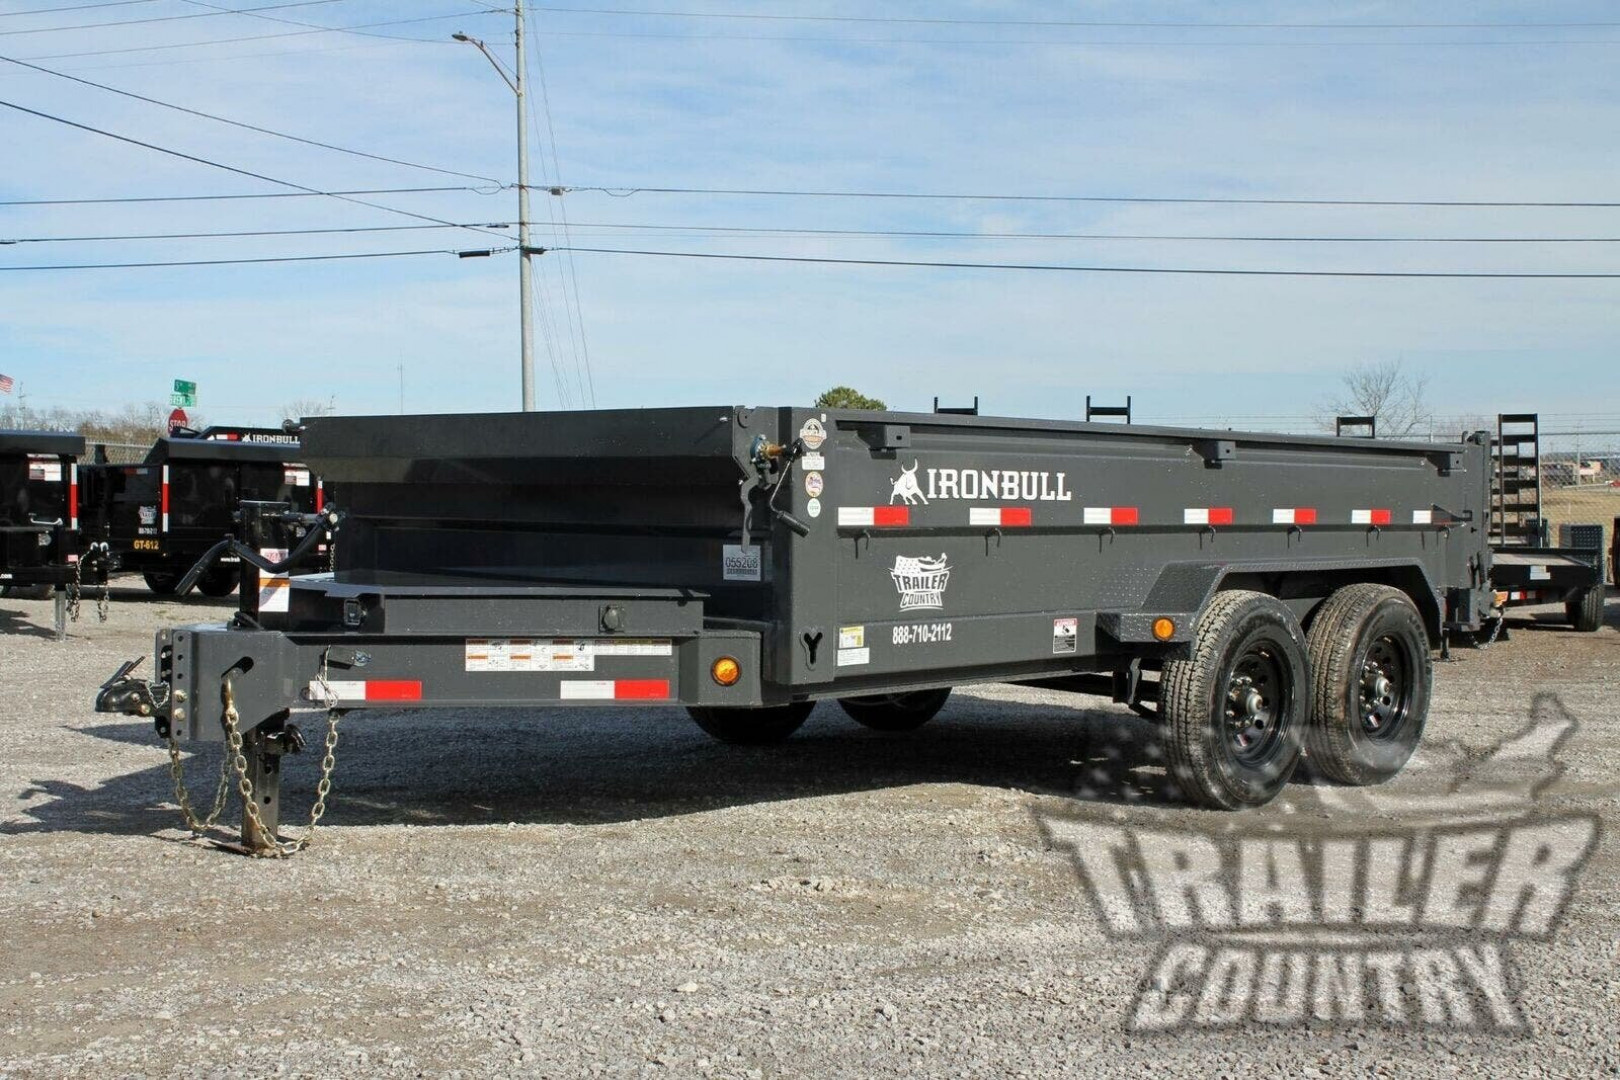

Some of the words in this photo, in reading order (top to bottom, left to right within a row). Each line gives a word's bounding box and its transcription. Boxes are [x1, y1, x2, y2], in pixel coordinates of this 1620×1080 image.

[252, 434, 300, 444] IRONBULL
[927, 468, 1072, 501] IRONBULL
[133, 539, 159, 550] GT-612
[892, 571, 949, 592] TRAILER
[901, 591, 942, 608] COUNTRY
[893, 622, 952, 645] 888-710-2112
